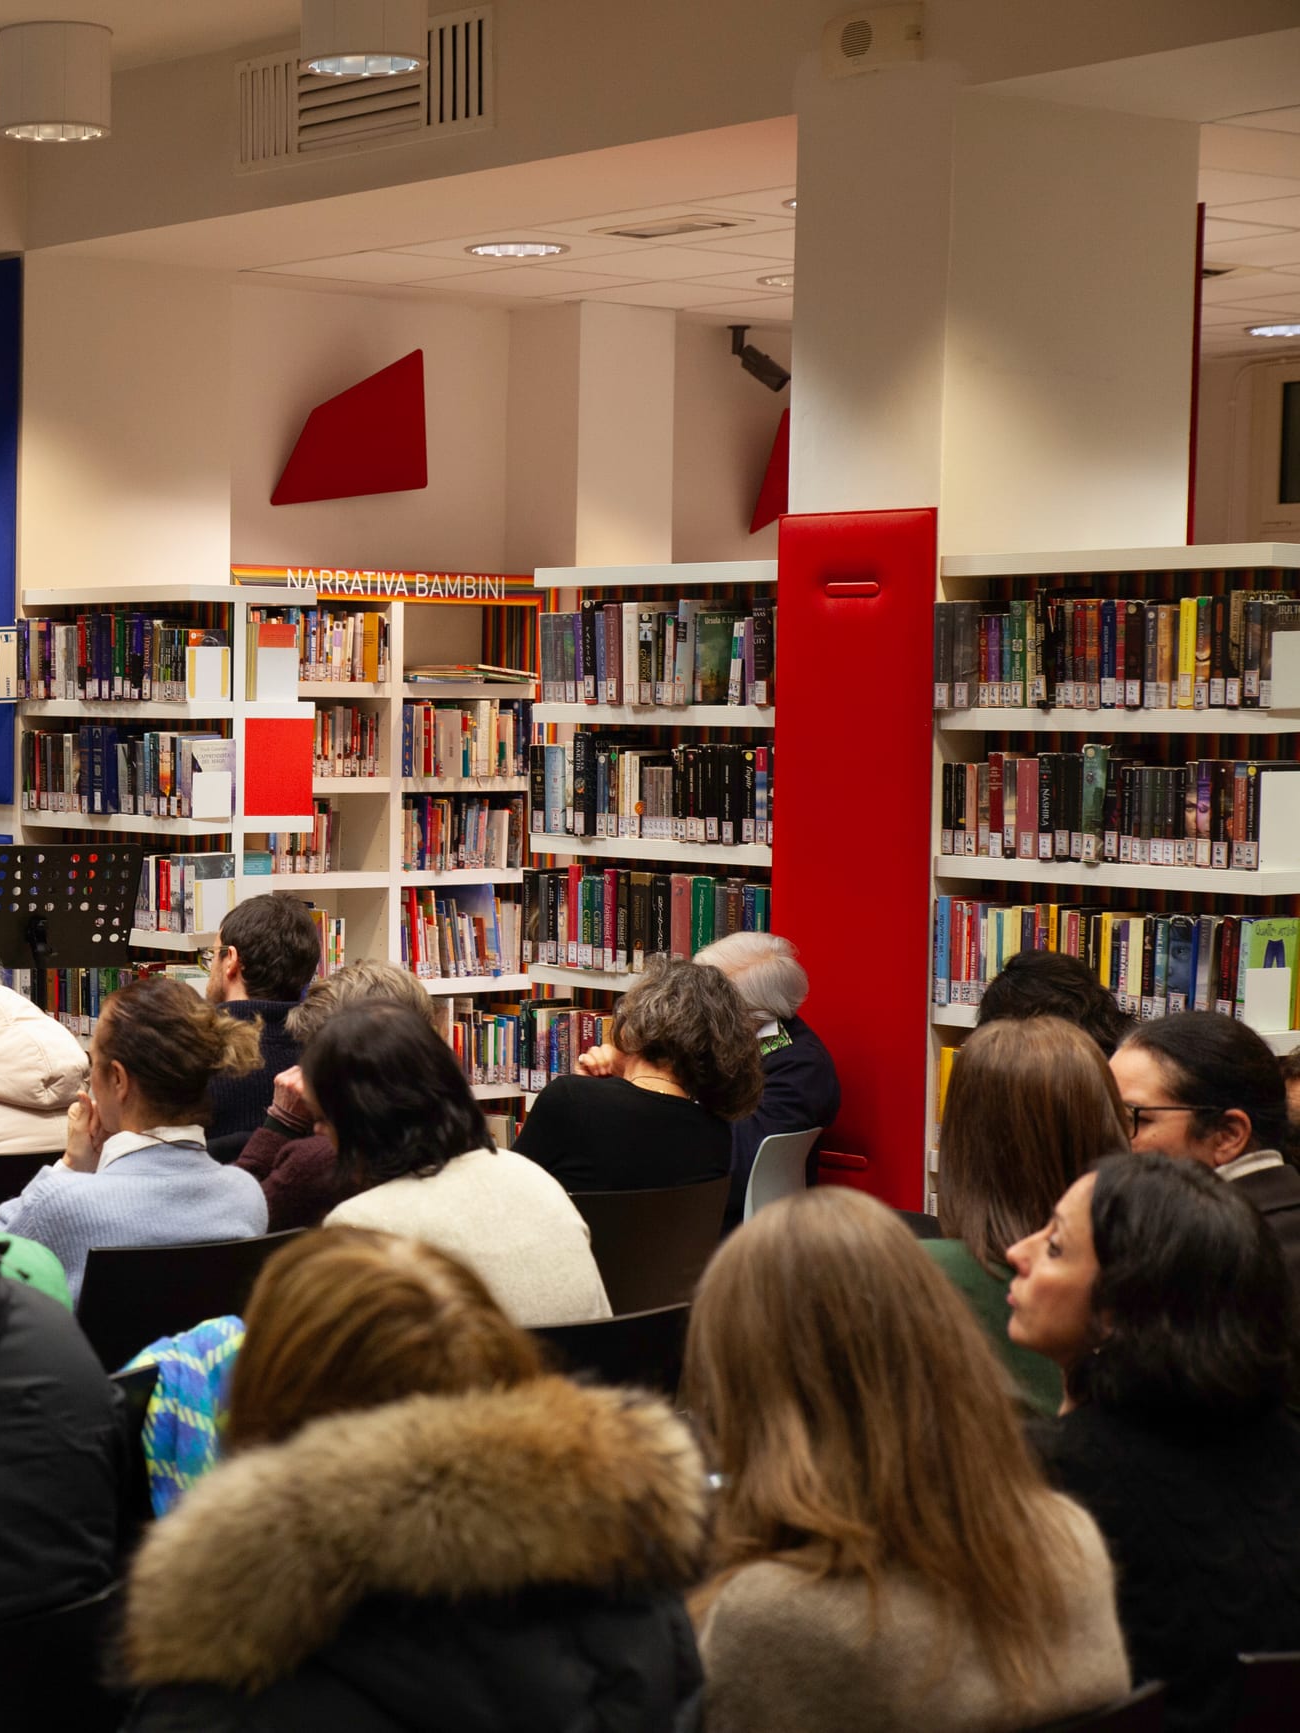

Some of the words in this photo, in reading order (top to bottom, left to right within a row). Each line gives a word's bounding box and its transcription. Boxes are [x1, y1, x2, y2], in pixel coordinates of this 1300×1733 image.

[286, 568, 409, 597] NARRATIVA
[415, 573, 506, 600] BAMBINI
[1041, 789, 1051, 826] NASHIRA
